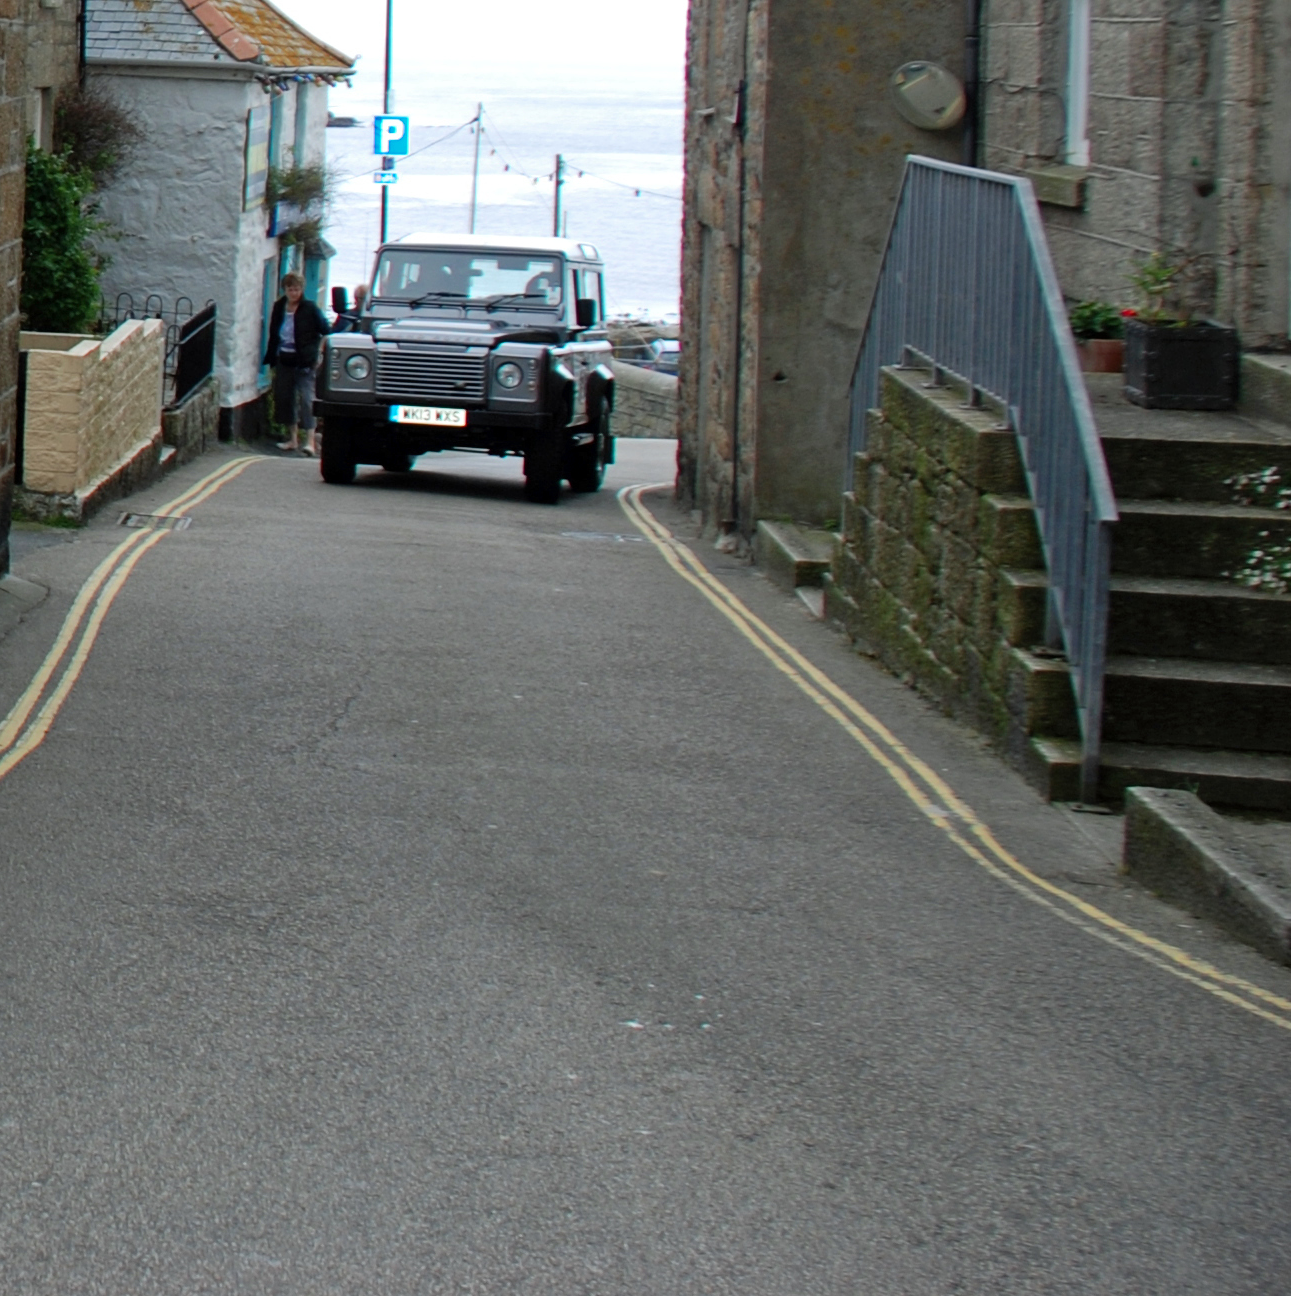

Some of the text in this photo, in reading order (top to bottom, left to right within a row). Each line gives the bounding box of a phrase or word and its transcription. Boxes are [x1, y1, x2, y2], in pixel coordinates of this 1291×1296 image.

[380, 119, 405, 153] P
[403, 408, 460, 423] WK13 WXS
